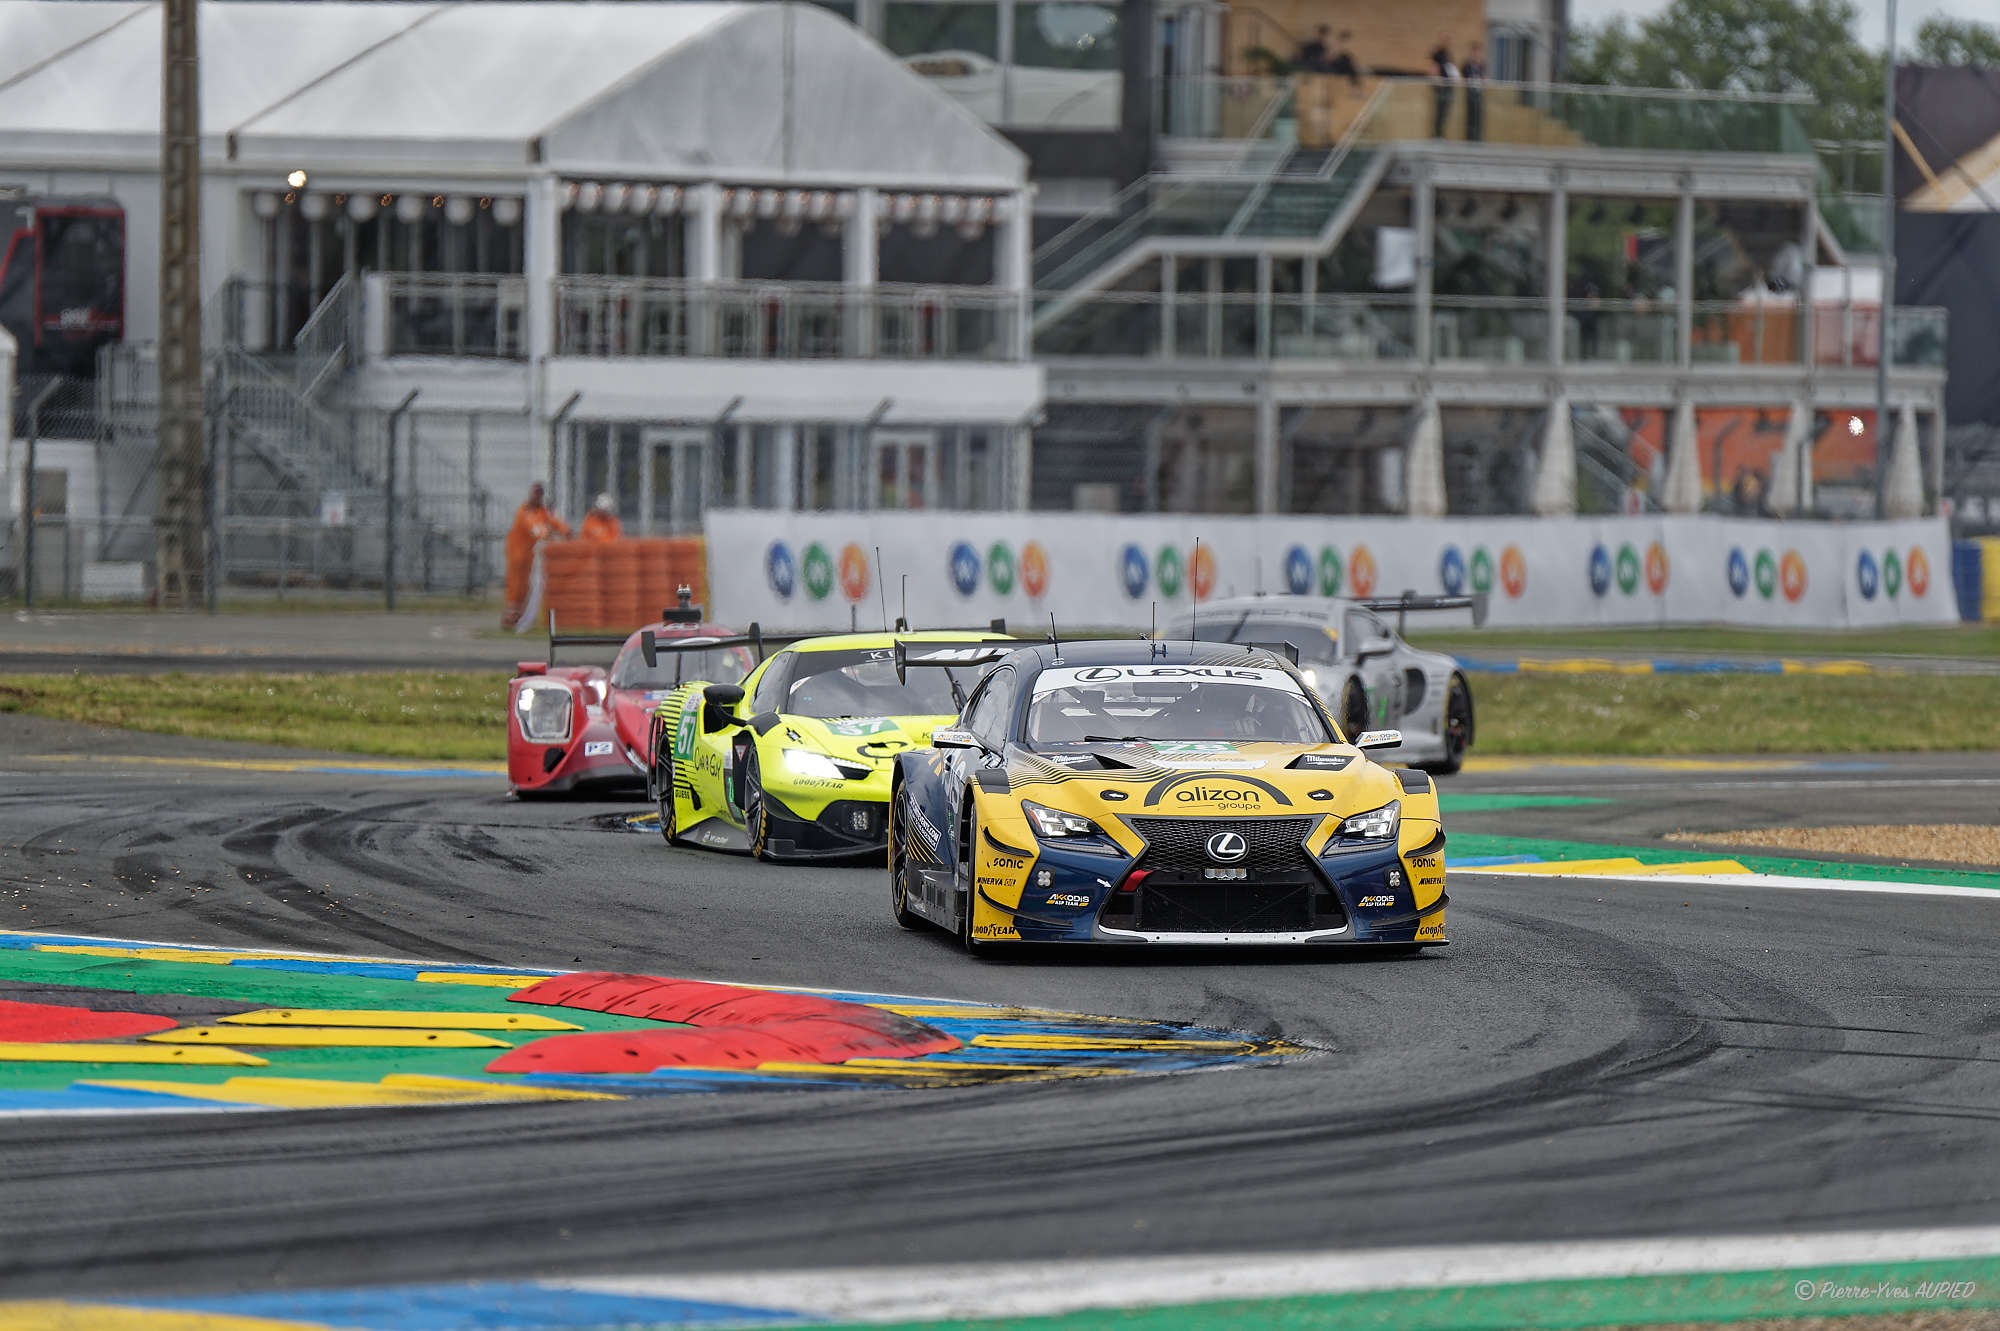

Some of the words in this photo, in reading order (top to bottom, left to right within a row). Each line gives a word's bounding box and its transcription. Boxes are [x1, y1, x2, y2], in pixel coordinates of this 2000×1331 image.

[1127, 668, 1263, 680] LEXUS
[677, 715, 697, 754] 57
[587, 743, 610, 754] P2
[1305, 754, 1345, 763] Milwaukee
[793, 779, 844, 790] GOODYEAR
[1176, 786, 1259, 802] alizon
[1217, 802, 1261, 811] groupe
[993, 857, 1024, 869] SONIC
[1412, 857, 1436, 868] SONIC
[977, 876, 1003, 886] MINERVA
